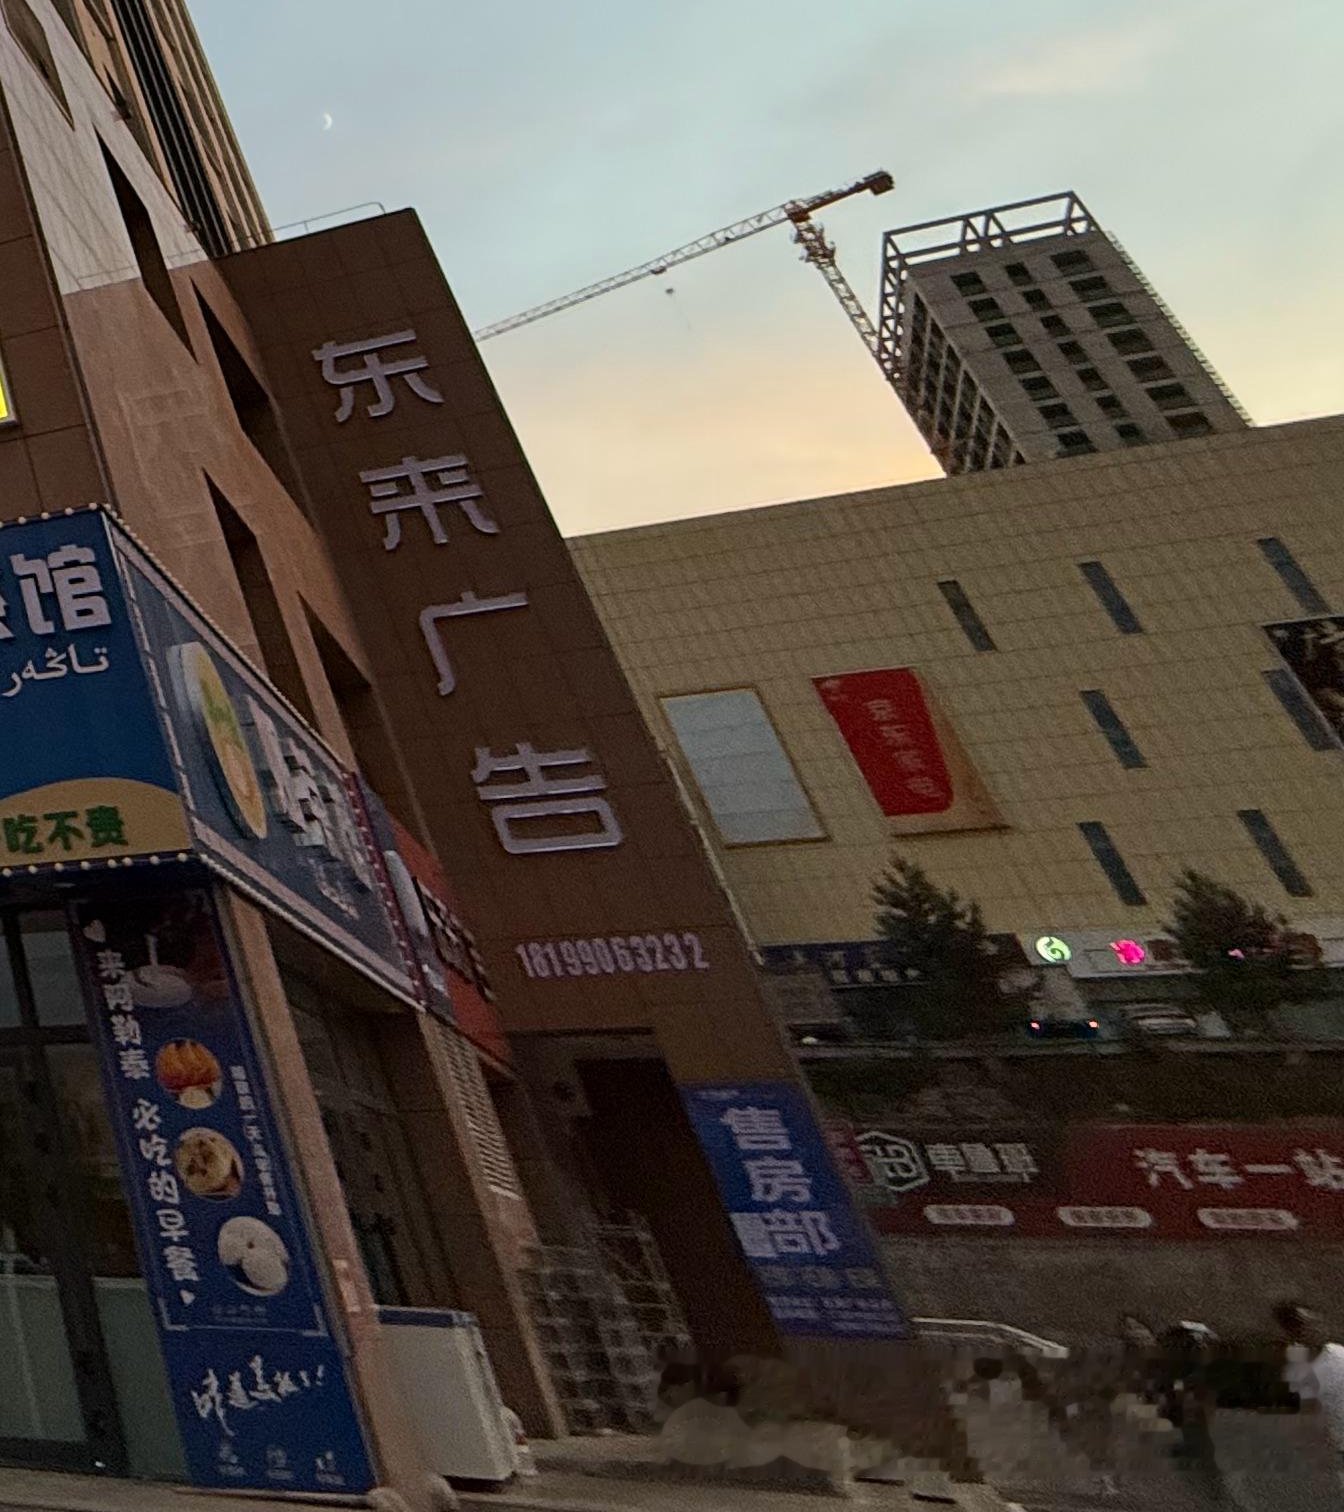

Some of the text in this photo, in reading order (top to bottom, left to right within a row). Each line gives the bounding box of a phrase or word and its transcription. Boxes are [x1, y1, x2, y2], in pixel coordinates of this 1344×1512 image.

[313, 330, 623, 855] 东来广告
[721, 1105, 843, 1258] 售房部
